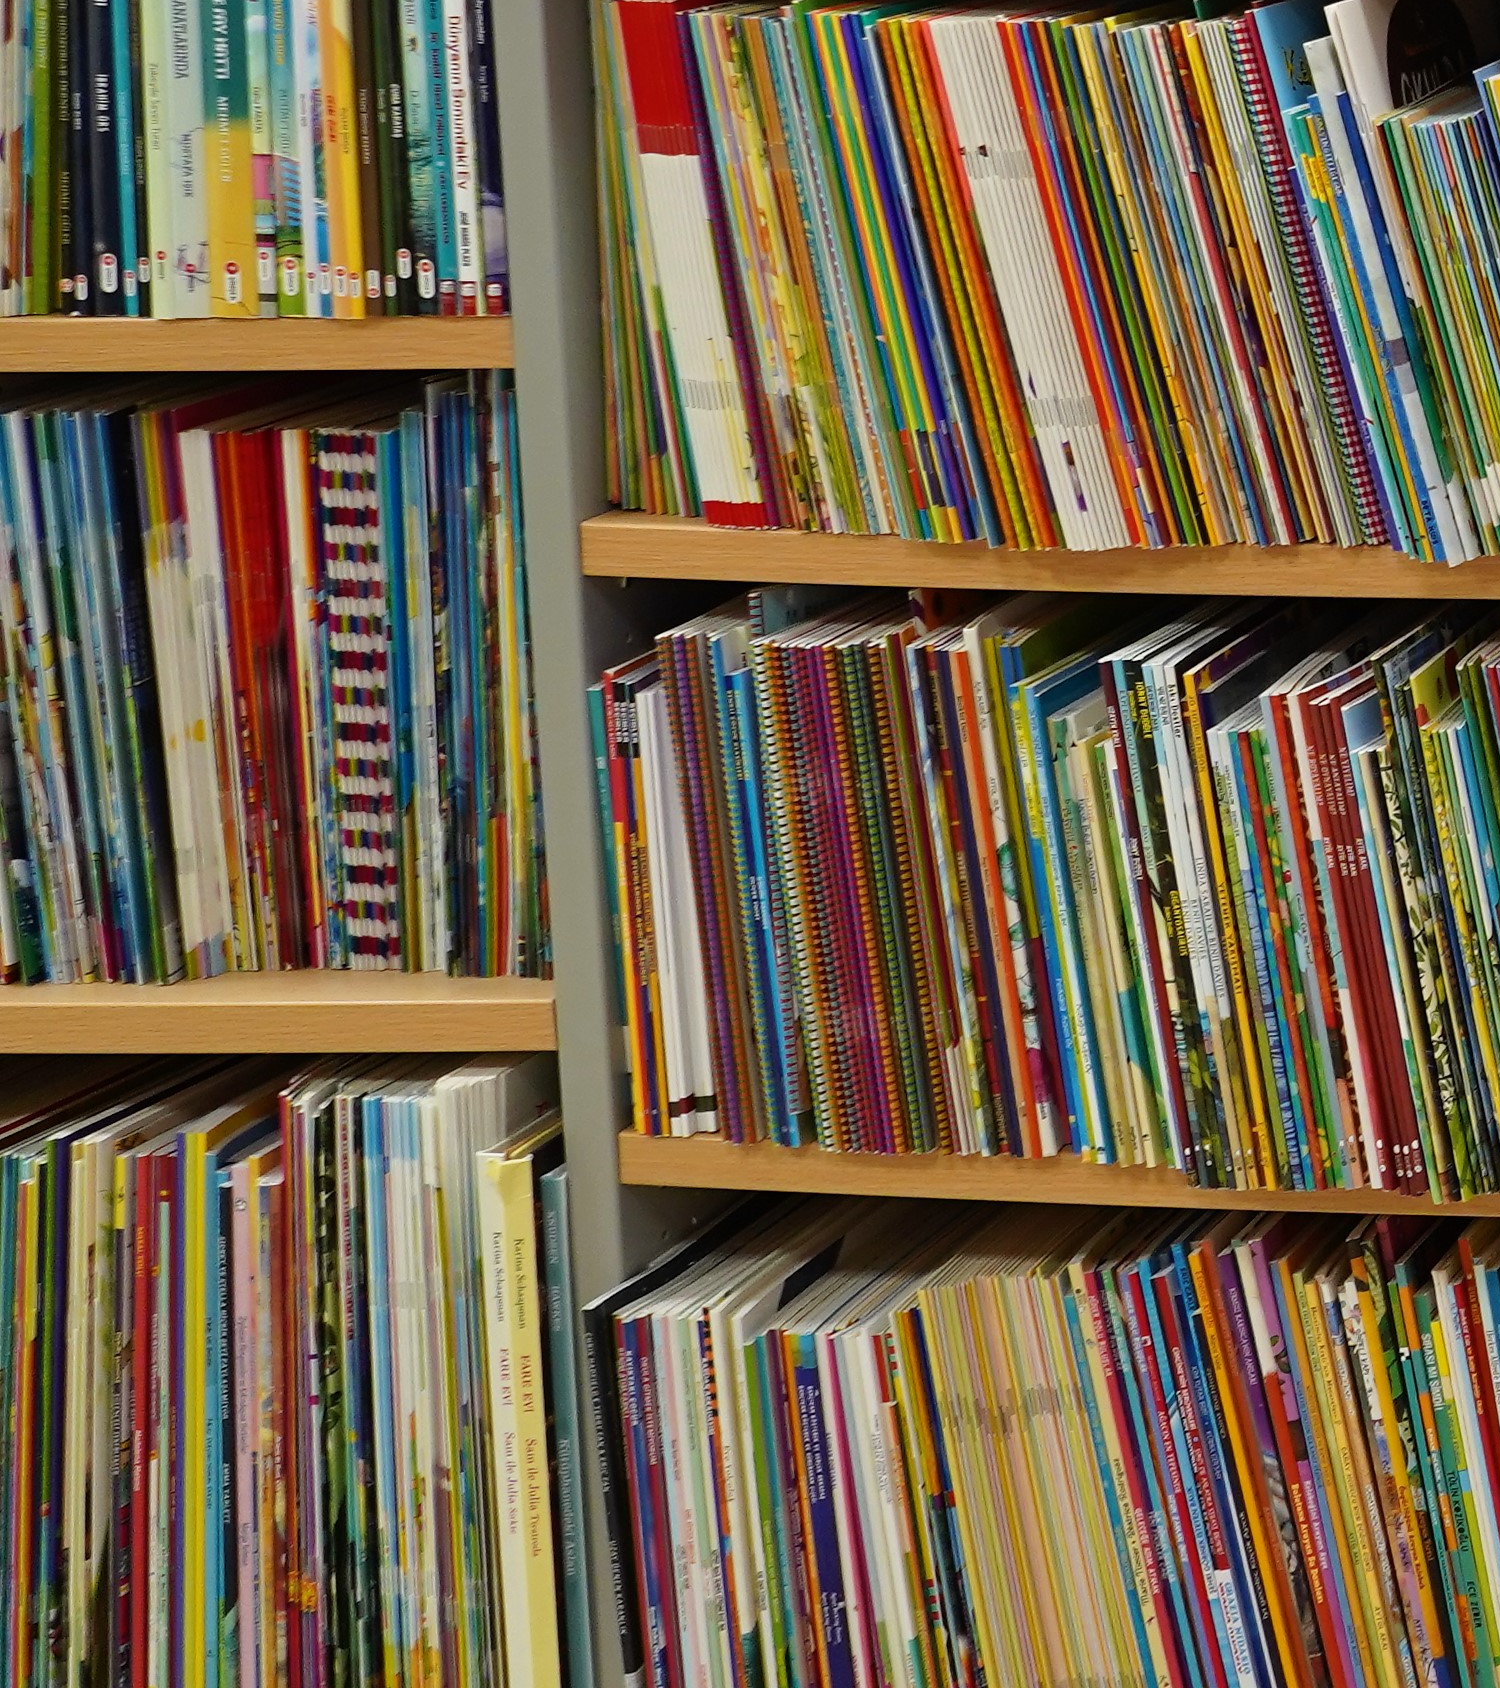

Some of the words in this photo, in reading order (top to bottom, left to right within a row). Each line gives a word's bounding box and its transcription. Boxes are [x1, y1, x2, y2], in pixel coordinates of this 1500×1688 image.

[1171, 889, 1190, 958] GIGANTOSAURUS
[492, 1230, 505, 1265] Karina
[513, 1237, 526, 1272] Karina
[493, 1266, 507, 1323] Schaapman
[513, 1273, 530, 1330] Schaapman
[499, 1346, 513, 1381] FARE
[520, 1354, 534, 1388] FARE
[501, 1386, 515, 1406] EVİ
[522, 1392, 536, 1414] EVİ
[525, 1437, 538, 1460] Sam
[526, 1462, 539, 1481] ile
[1446, 1470, 1461, 1497] TÜLİN
[528, 1483, 542, 1511] Julia
[1451, 1498, 1470, 1552] KOZİKOĞLU
[1465, 1579, 1478, 1598] ECE
[1468, 1599, 1484, 1629] ZEBER
